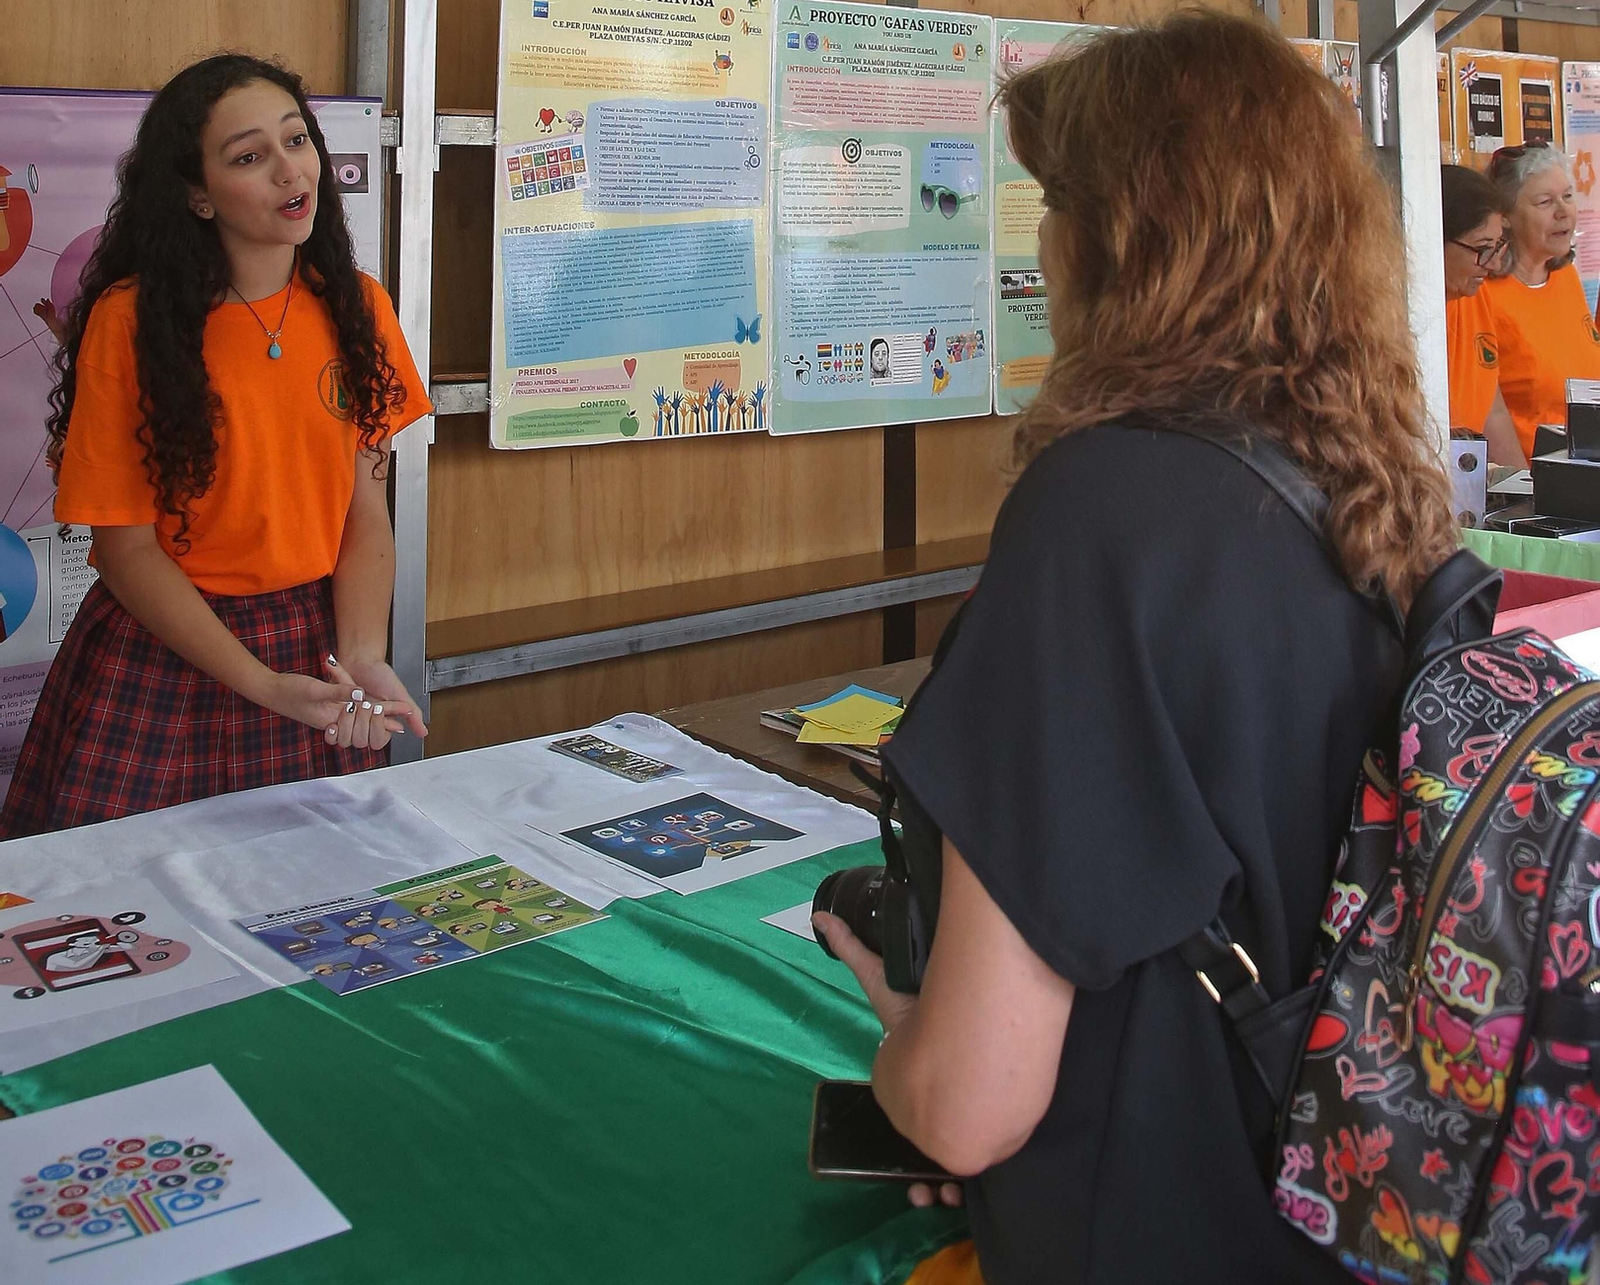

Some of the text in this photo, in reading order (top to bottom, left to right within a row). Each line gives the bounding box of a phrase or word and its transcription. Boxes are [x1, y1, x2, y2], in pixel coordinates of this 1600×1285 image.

[592, 7, 696, 22] ANA MARÍA SÁNCHEZ GARCÍA
[810, 10, 978, 36] PROYECTO "GAFAS VERDES"
[552, 20, 580, 30] C.E.PER
[582, 22, 602, 31] JUAN
[604, 24, 630, 34] RAMÓN
[666, 30, 704, 40] ALGECIRAS
[706, 32, 730, 42] (CÁDIZ)
[590, 32, 614, 40] PLAZA
[614, 34, 645, 42] OMEYAS
[662, 38, 692, 46] C.P.11202
[522, 44, 587, 56] INTRODUCCIÓN
[890, 45, 916, 54] SÁNCHEZ
[917, 47, 938, 55] GARCÍA
[863, 58, 885, 66] RAMÓN
[914, 62, 944, 70] ALGECIRAS
[787, 65, 841, 74] INTRODUCCIÓN
[715, 100, 758, 110] OBJETIVOS
[521, 142, 555, 154] OBJETIVOS
[504, 222, 596, 235] INTER-ACTUACIONES
[1007, 304, 1044, 313] PROYECTO
[684, 350, 740, 360] METODOLOGÍA
[518, 368, 558, 376] PREMIOS
[580, 400, 626, 408] CONTACTO
[62, 564, 88, 574] grupos
[62, 573, 90, 582] miento
[62, 582, 86, 590] centes
[406, 874, 436, 884] Para
[265, 909, 297, 919] Para
